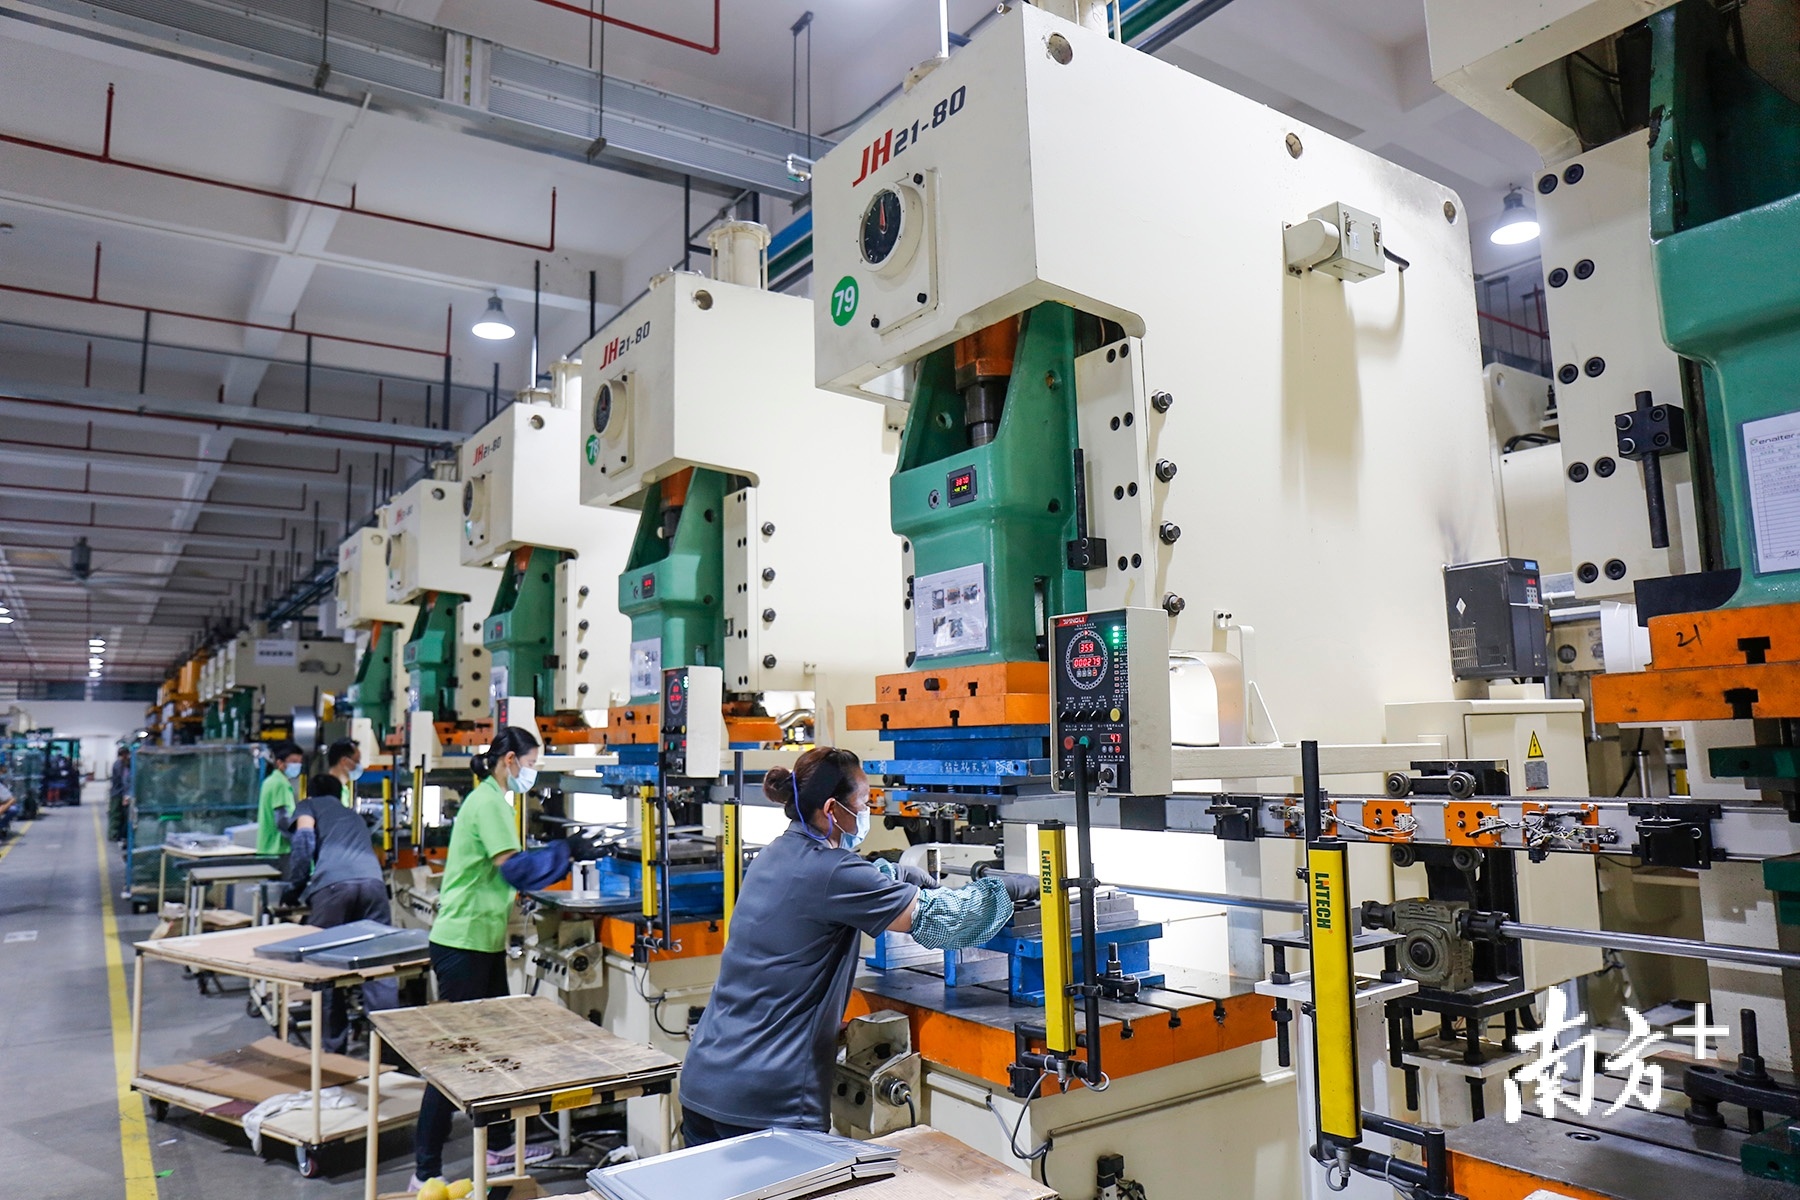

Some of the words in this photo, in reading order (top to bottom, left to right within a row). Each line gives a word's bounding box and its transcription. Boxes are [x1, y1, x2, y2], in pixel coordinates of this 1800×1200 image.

[852, 85, 967, 188] JH21-80
[834, 285, 856, 317] 79
[600, 321, 651, 371] JH21-80
[472, 436, 502, 467] JH21-80
[588, 439, 600, 460] 78
[1079, 643, 1094, 653] 359
[1675, 624, 1704, 648] 21
[1110, 733, 1121, 743] 47
[1315, 872, 1332, 929] LNTECH
